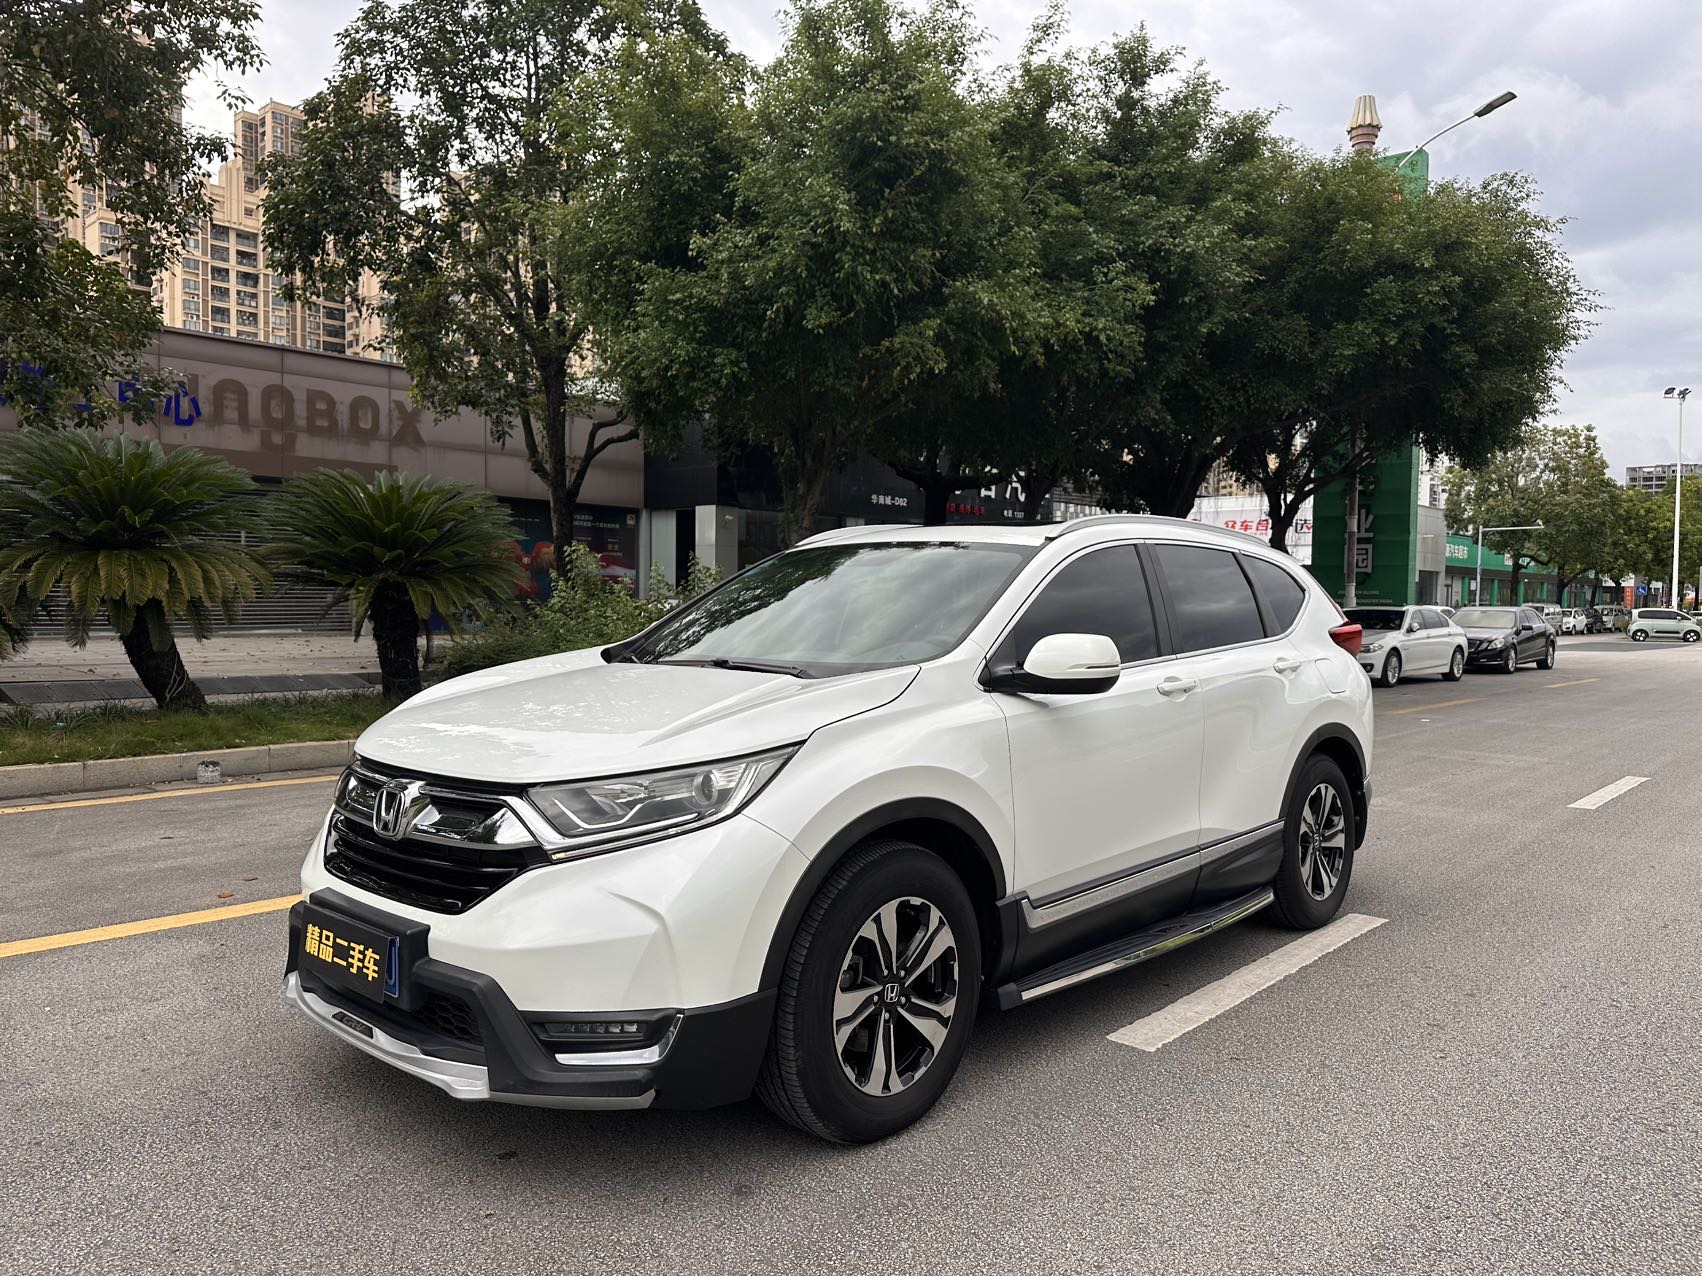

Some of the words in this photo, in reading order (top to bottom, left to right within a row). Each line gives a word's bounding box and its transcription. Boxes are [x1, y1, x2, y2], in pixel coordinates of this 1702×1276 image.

[305, 923, 380, 981] 精品二手车
